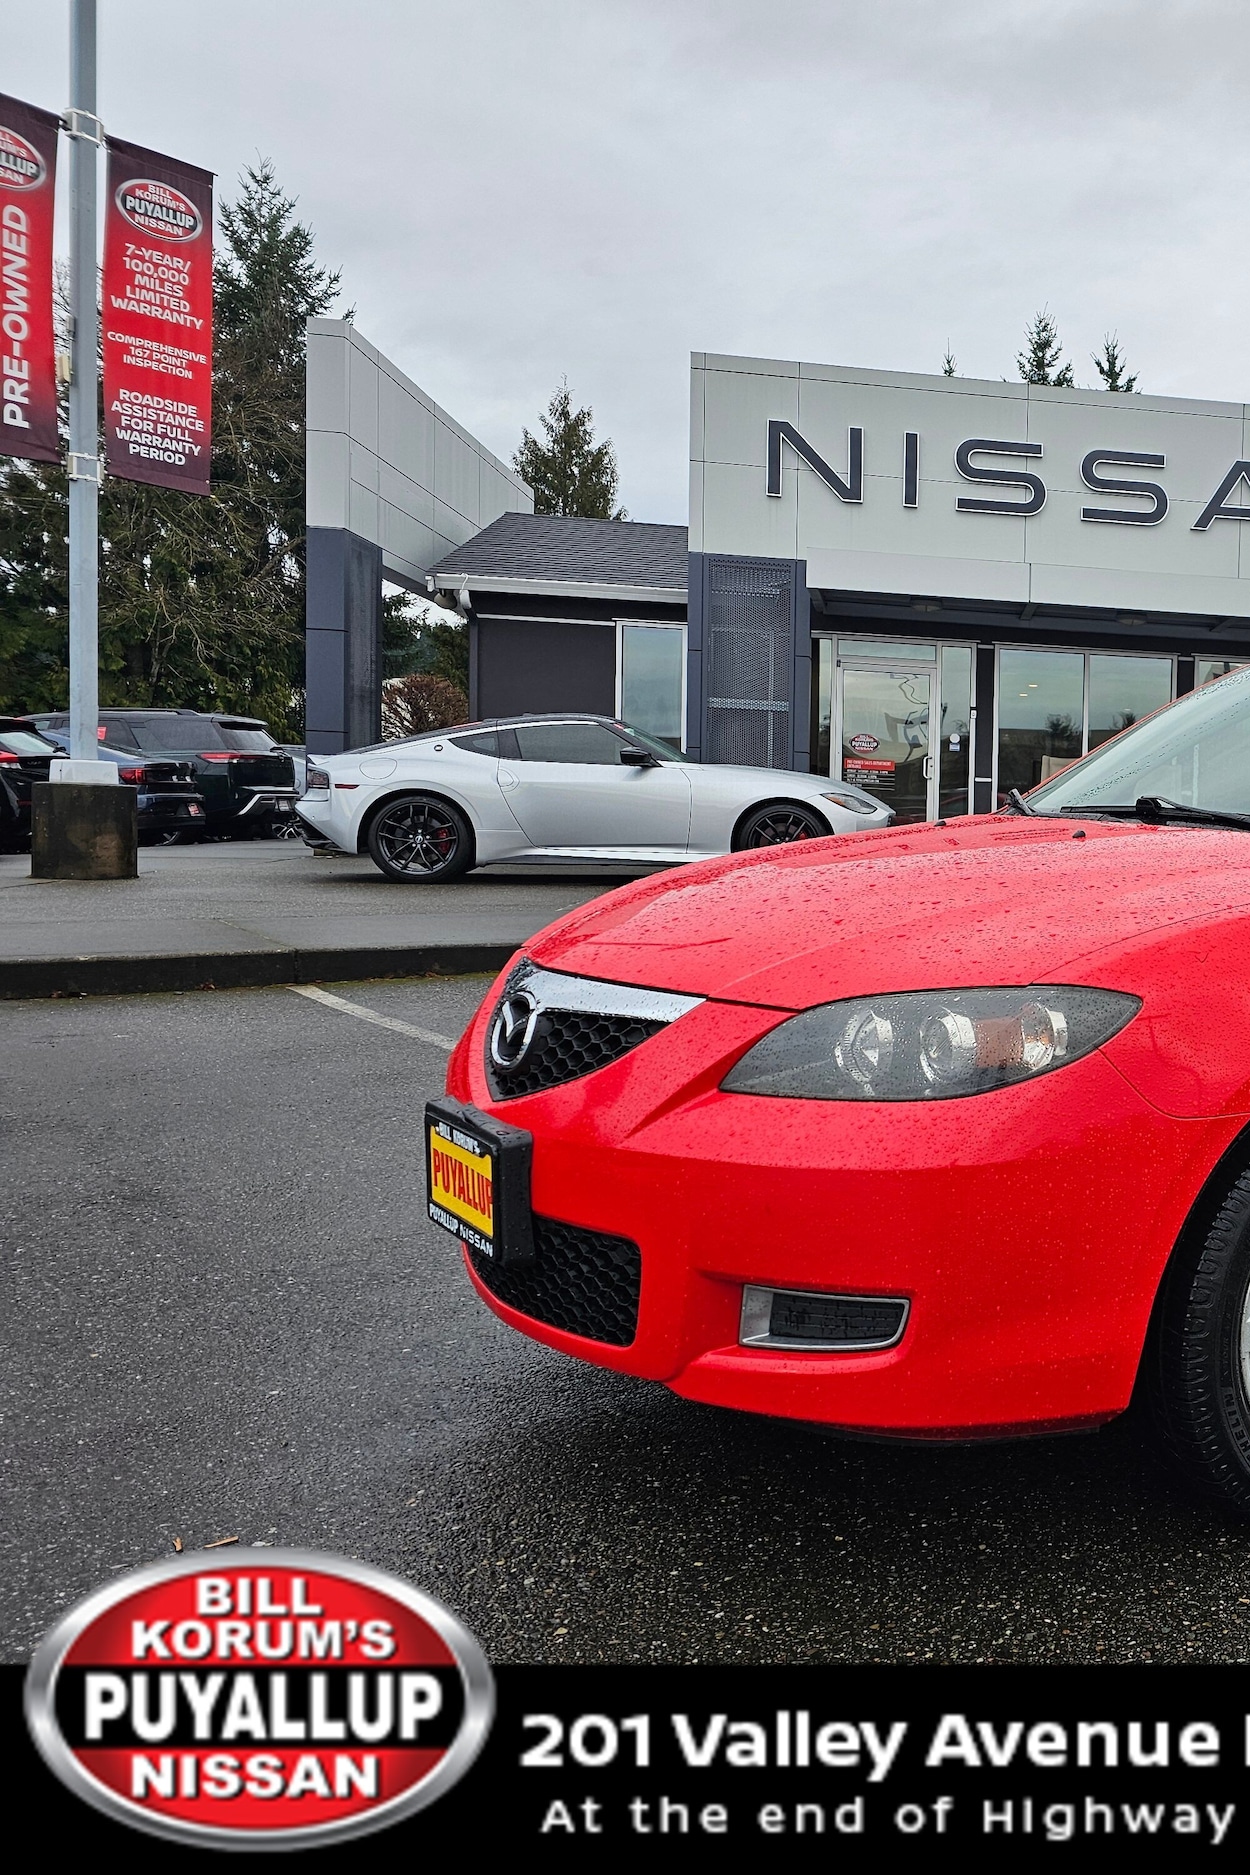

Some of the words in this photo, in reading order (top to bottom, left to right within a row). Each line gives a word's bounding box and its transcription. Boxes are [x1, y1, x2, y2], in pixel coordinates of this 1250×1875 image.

[0, 140, 27, 157] UM'S
[0, 151, 37, 176] LLUP
[0, 169, 24, 184] SAN
[135, 188, 186, 212] KORUM'S
[148, 184, 173, 199] BILL
[126, 195, 194, 228] PUYALLUP
[134, 214, 183, 236] NISSAN
[122, 257, 189, 286] 100,000
[125, 243, 191, 272] 7-YEAR/
[126, 285, 190, 313] LIMITED
[134, 274, 183, 297] MILES
[2, 204, 30, 429] PRE-OWNED
[110, 295, 203, 330] WARRANTY
[107, 331, 207, 364] COMPREHENSIVE
[129, 346, 150, 357] 167
[152, 352, 187, 368] POINT
[123, 354, 193, 379] INSPECTION
[111, 400, 204, 432] ASSISTANCE
[119, 388, 197, 418] ROADSIDE
[115, 427, 201, 456] WARRANTY
[121, 416, 154, 433] FOR
[157, 423, 193, 442] FULL
[128, 443, 186, 466] PERIOD
[432, 1148, 493, 1219] PUYALLUP
[459, 1224, 493, 1258] NISSAN
